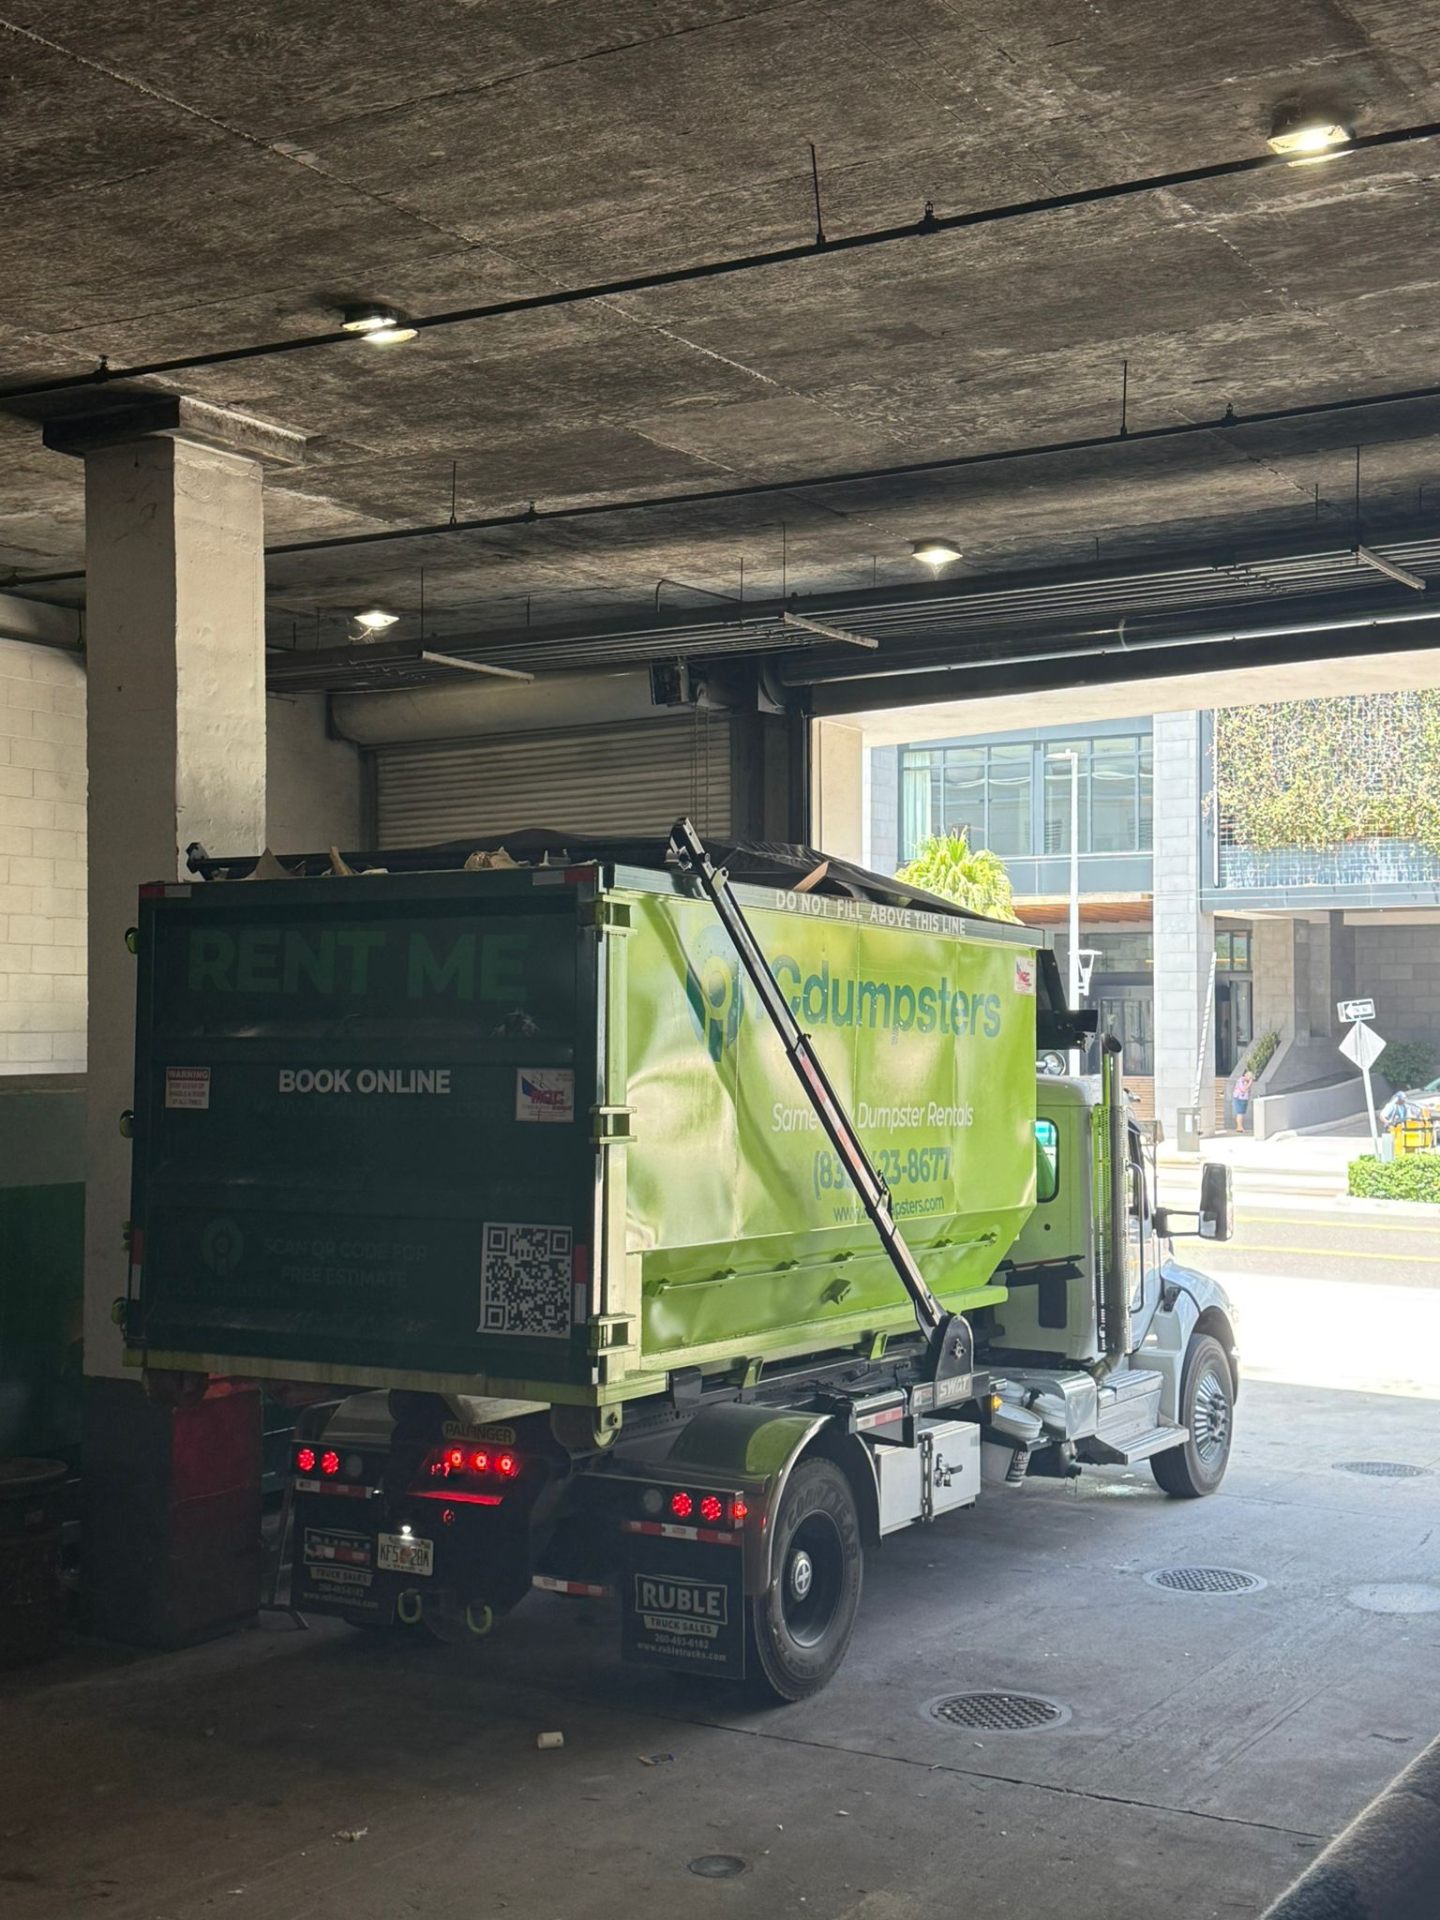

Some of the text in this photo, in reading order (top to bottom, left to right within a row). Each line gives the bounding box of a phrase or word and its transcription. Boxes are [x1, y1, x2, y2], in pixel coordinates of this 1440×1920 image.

[775, 890, 966, 934] DO NOT FILL ABOVE THIS LINE
[188, 928, 530, 1000] RENT ME
[756, 954, 1001, 1038] Cdumpsters
[168, 1069, 208, 1079] WARNING
[278, 1069, 451, 1094] BOOK ONLINE
[857, 1102, 923, 1134] Dumpster
[927, 1102, 974, 1127] Rentals
[263, 1236, 428, 1263] SCAN QR CODE FOR
[280, 1265, 408, 1289] FREE ESTIMATE
[642, 1582, 721, 1617] RUBLE
[650, 1617, 713, 1634] TRUCK SALES
